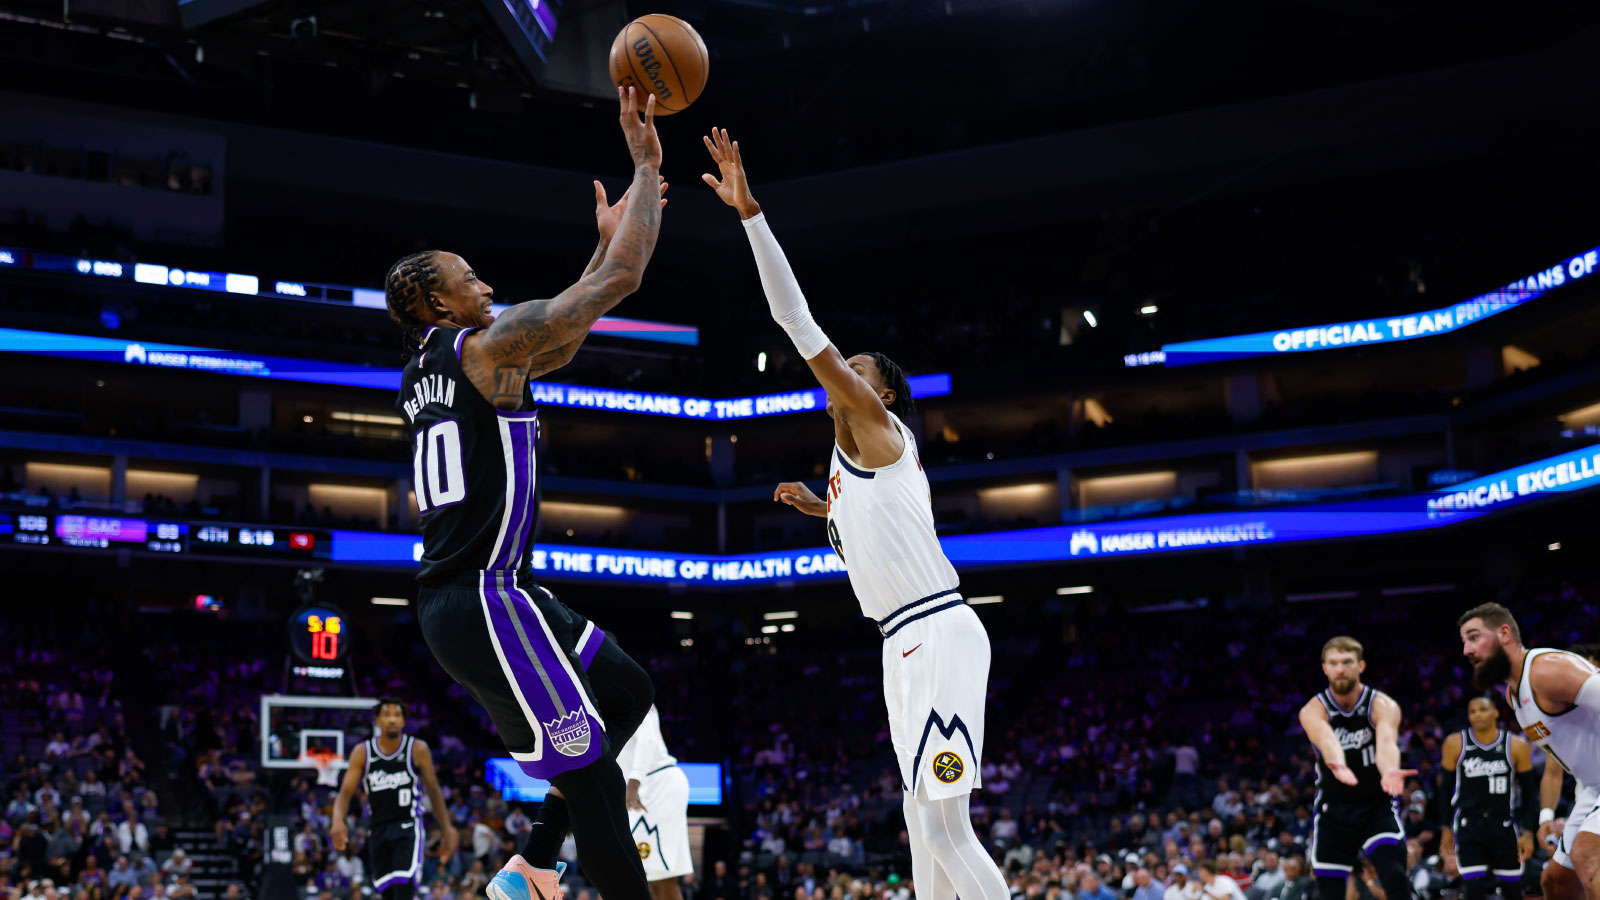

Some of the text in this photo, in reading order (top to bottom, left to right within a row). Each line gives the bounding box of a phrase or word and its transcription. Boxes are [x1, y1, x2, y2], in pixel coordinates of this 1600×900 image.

[633, 34, 673, 101] Wilson
[1273, 250, 1598, 351] OFFICIAL TEAM PHYSICIANS OF
[148, 351, 188, 367] KAISER
[403, 374, 456, 424] DeROZAN
[568, 387, 681, 415] PHYSICIANS
[683, 398, 711, 417] OF
[714, 398, 753, 418] THE
[756, 391, 815, 414] KINGS
[414, 420, 466, 513] 10
[1427, 479, 1514, 520] MEDICAL
[197, 527, 229, 543] 4TH
[1101, 531, 1156, 553] KAISER
[550, 551, 593, 573] THE
[596, 554, 676, 578] FUTURE
[679, 560, 709, 580] OF
[712, 557, 792, 581] HEALTH
[312, 631, 338, 660] 10
[552, 724, 590, 746] KINGS
[1361, 744, 1377, 768] 11
[1462, 756, 1508, 778] Kings
[368, 769, 411, 792] Kings
[1488, 776, 1507, 794] 18
[398, 788, 411, 807] 0
